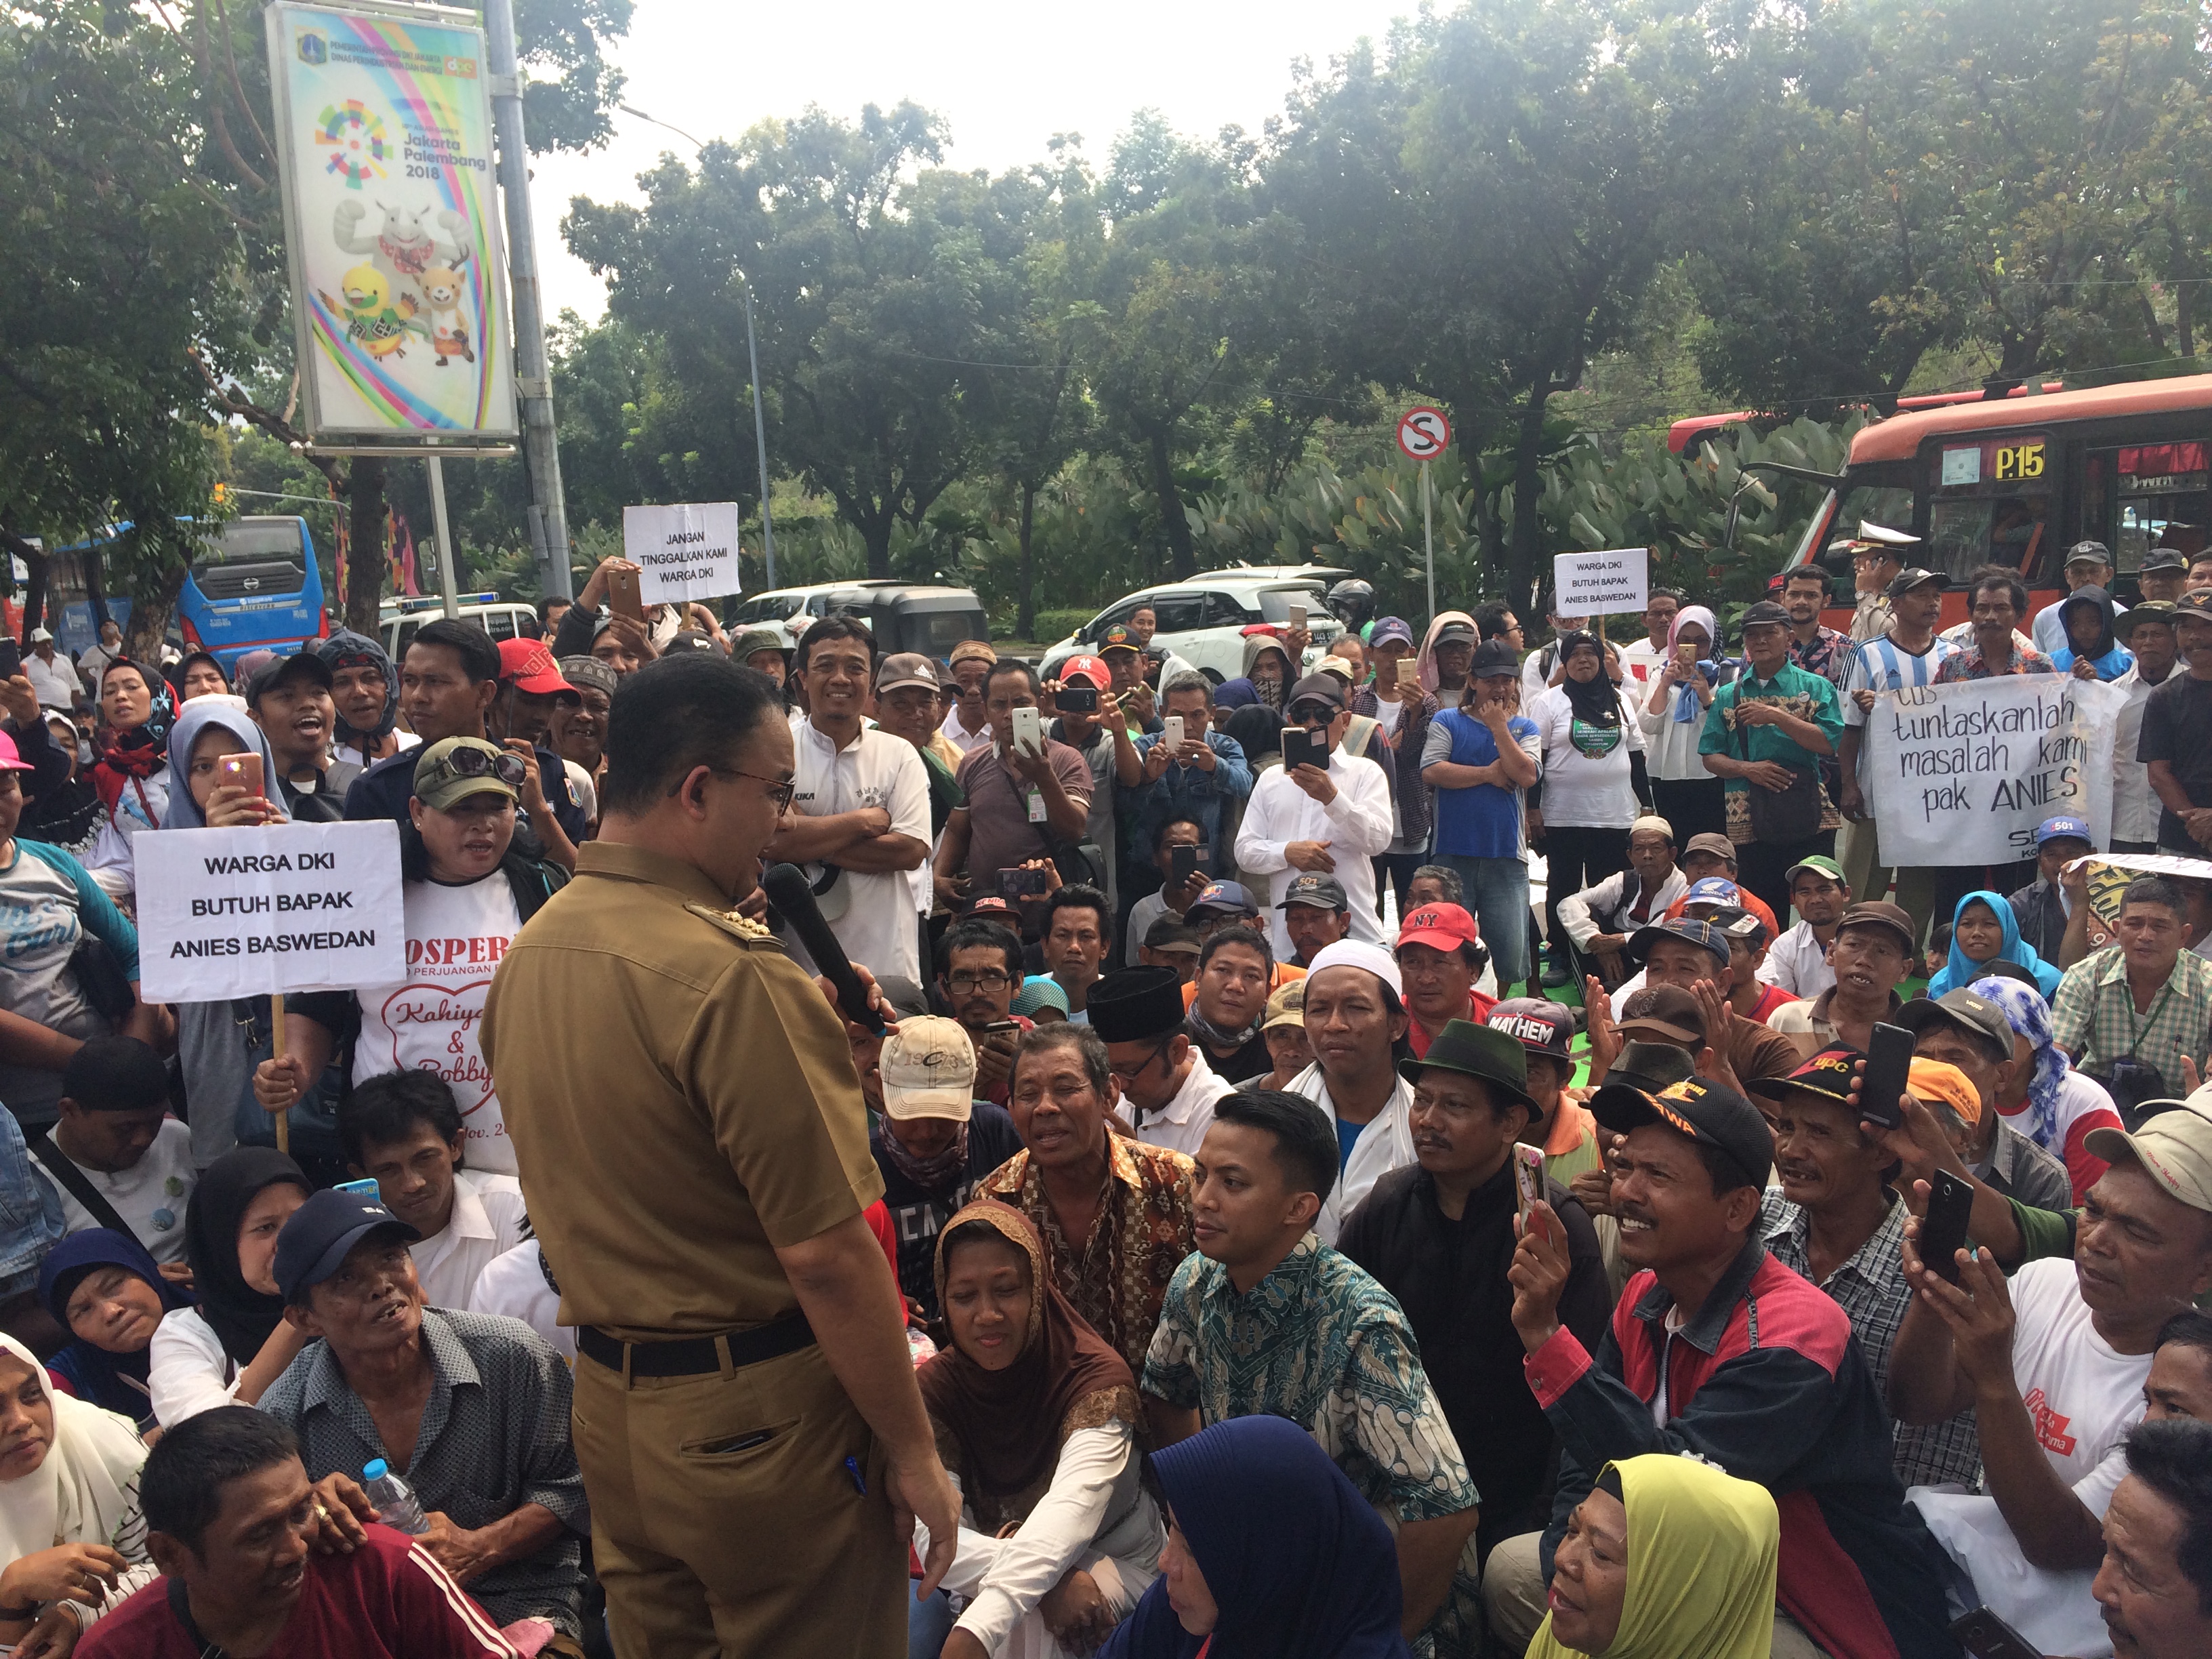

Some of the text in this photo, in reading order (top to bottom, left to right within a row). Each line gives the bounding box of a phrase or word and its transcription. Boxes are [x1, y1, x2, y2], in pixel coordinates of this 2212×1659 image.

[404, 133, 460, 150] Jakarta
[404, 148, 486, 171] Palembang
[406, 165, 440, 180] 2018
[1996, 445, 2045, 479] P.15
[667, 531, 704, 545] JANGAN
[640, 548, 727, 565] TINGGALKAN KAMI
[1577, 561, 1622, 571] WARGA DKI
[659, 567, 714, 583] WARGA DKI
[1572, 577, 1628, 588] BUTUH BAPAK
[1565, 592, 1636, 604] ANIES BASWEDAN
[1892, 692, 2075, 741] tuntaskanlah
[1900, 736, 2087, 777] masalah kami
[1922, 766, 2077, 823] pak ANIES
[205, 853, 335, 875] WARGA DKI
[192, 891, 353, 916] BUTUH BAPAK
[976, 898, 1006, 908] KENDA
[1414, 914, 1437, 926] NY
[169, 930, 375, 958] ANIES BASWEDAN
[414, 965, 491, 976] PERJUANGAN
[1489, 1017, 1555, 1044] MAYHEM
[447, 1030, 464, 1054] &
